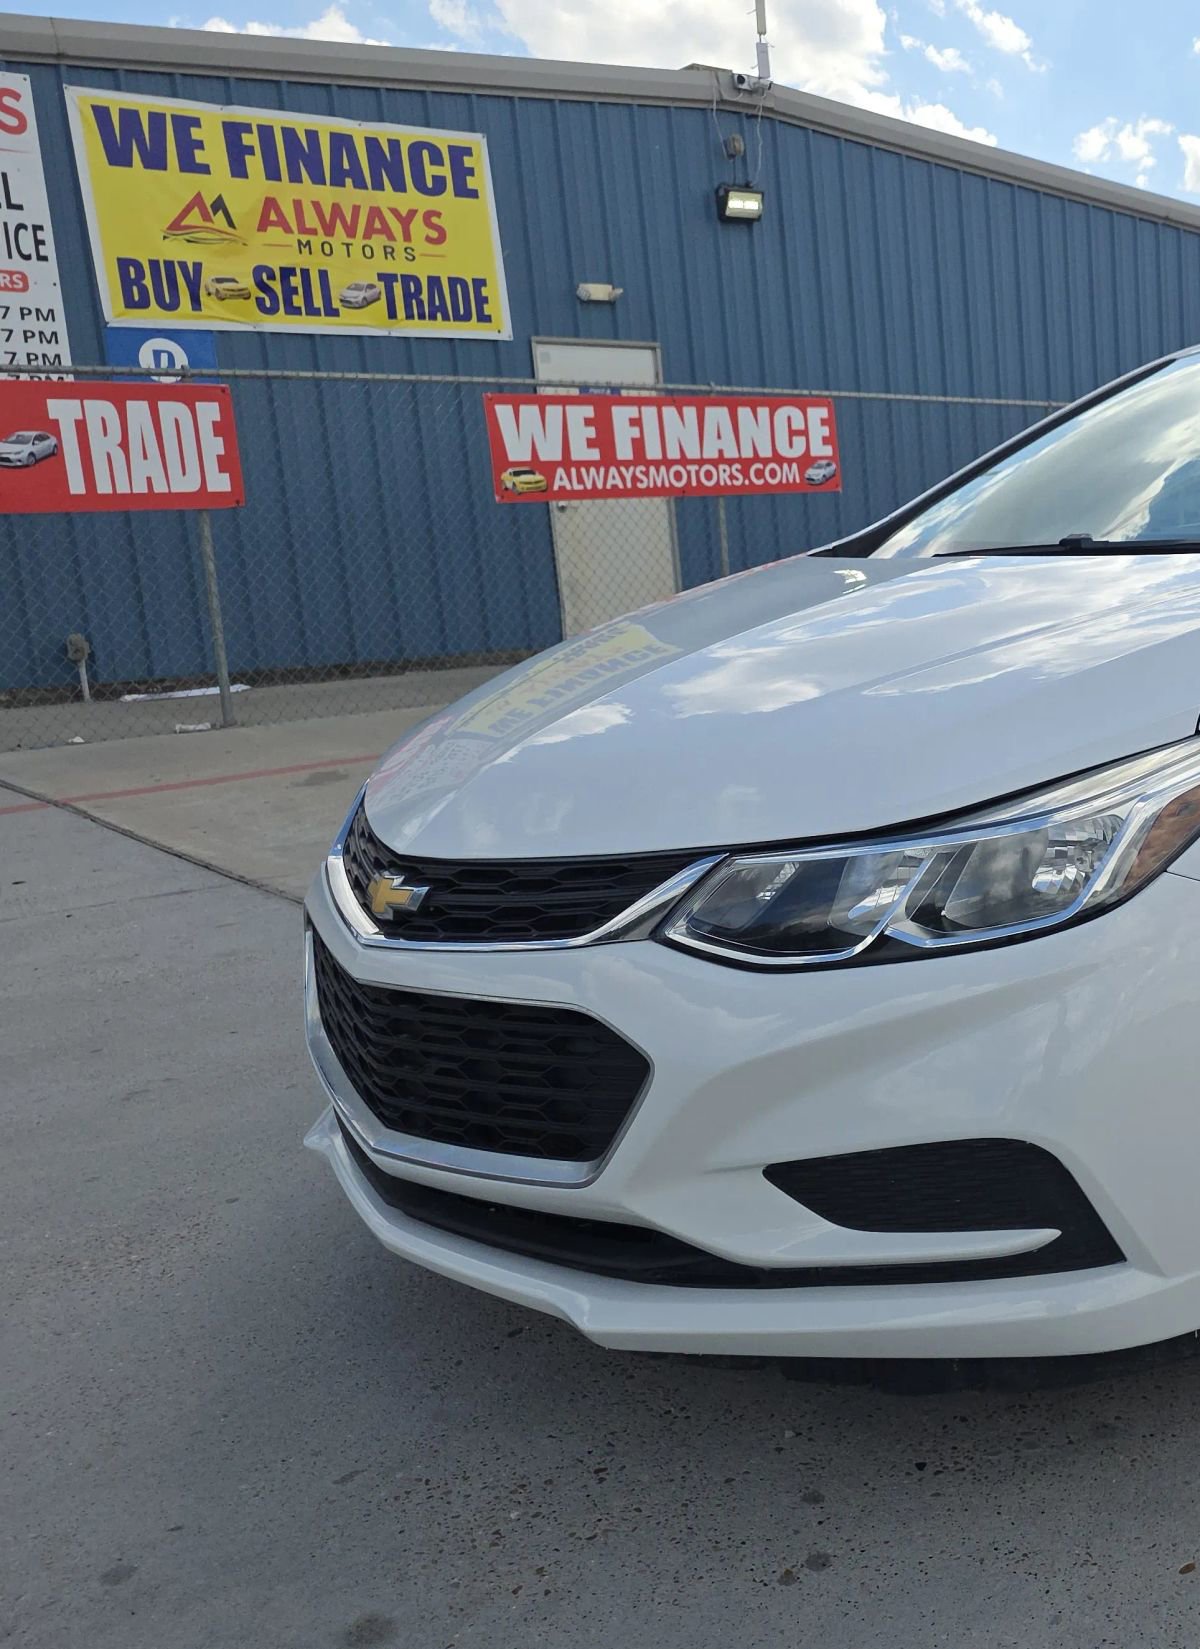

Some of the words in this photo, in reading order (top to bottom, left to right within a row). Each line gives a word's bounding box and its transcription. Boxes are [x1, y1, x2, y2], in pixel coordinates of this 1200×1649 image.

[90, 104, 211, 175] WE
[222, 120, 480, 199] FINANCE
[0, 171, 24, 211] L
[257, 197, 448, 245] ALWAYS
[298, 239, 417, 262] MOTORS
[116, 257, 203, 312] BUY
[252, 264, 340, 318] SELL
[378, 272, 493, 323] TRADE
[19, 307, 56, 322] PM
[0, 329, 13, 343] 7
[22, 330, 59, 345] PM
[4, 351, 17, 365] 7
[26, 352, 62, 366] PM
[46, 399, 232, 495] TRADE
[495, 405, 600, 461] WE
[611, 406, 833, 460] FINANCE
[553, 463, 800, 491] ALWAYSMOTORS.COM
